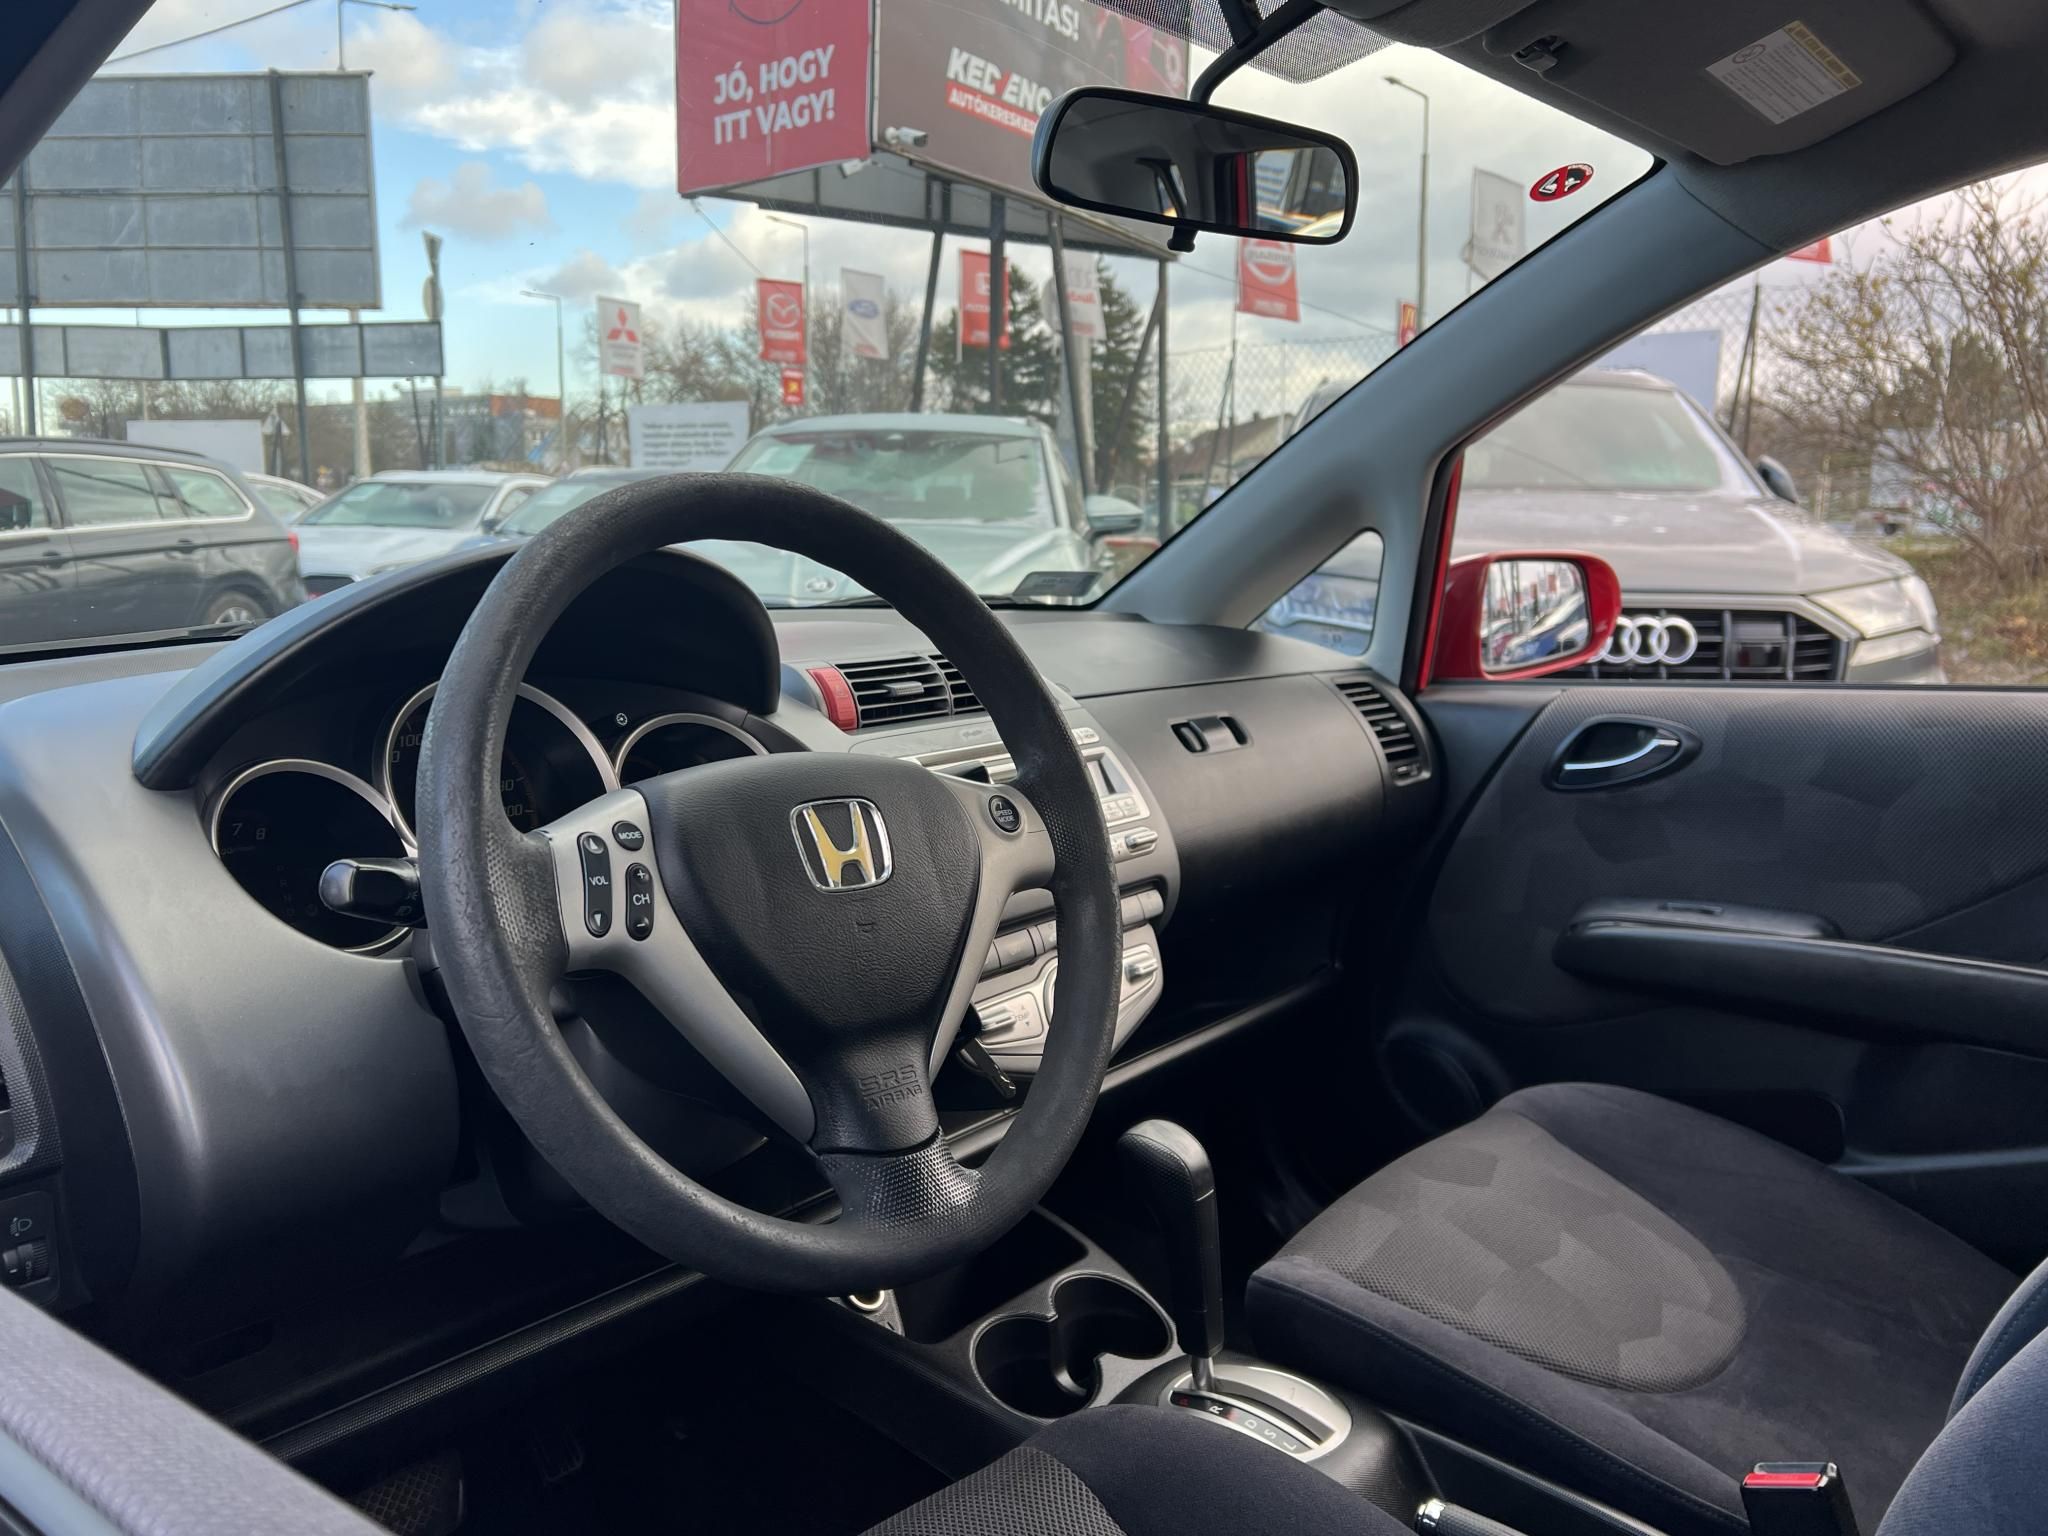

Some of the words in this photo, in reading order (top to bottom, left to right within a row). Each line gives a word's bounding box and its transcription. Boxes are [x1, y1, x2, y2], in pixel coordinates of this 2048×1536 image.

[714, 61, 753, 104] JÓ,
[759, 44, 835, 94] HOGY
[714, 108, 752, 144] ITT
[755, 88, 835, 135] VAGY!
[999, 815, 1015, 823] MODE
[232, 823, 243, 836] 7
[256, 828, 266, 840] 8
[618, 831, 642, 840] MODE
[589, 875, 609, 886] VOL
[632, 893, 650, 906] CH
[859, 1064, 917, 1093] SRS
[867, 1084, 923, 1111] AIRBAG
[1209, 1405, 1223, 1414] R
[1244, 1419, 1257, 1429] D
[1264, 1428, 1277, 1440] S
[1283, 1441, 1297, 1452] L
